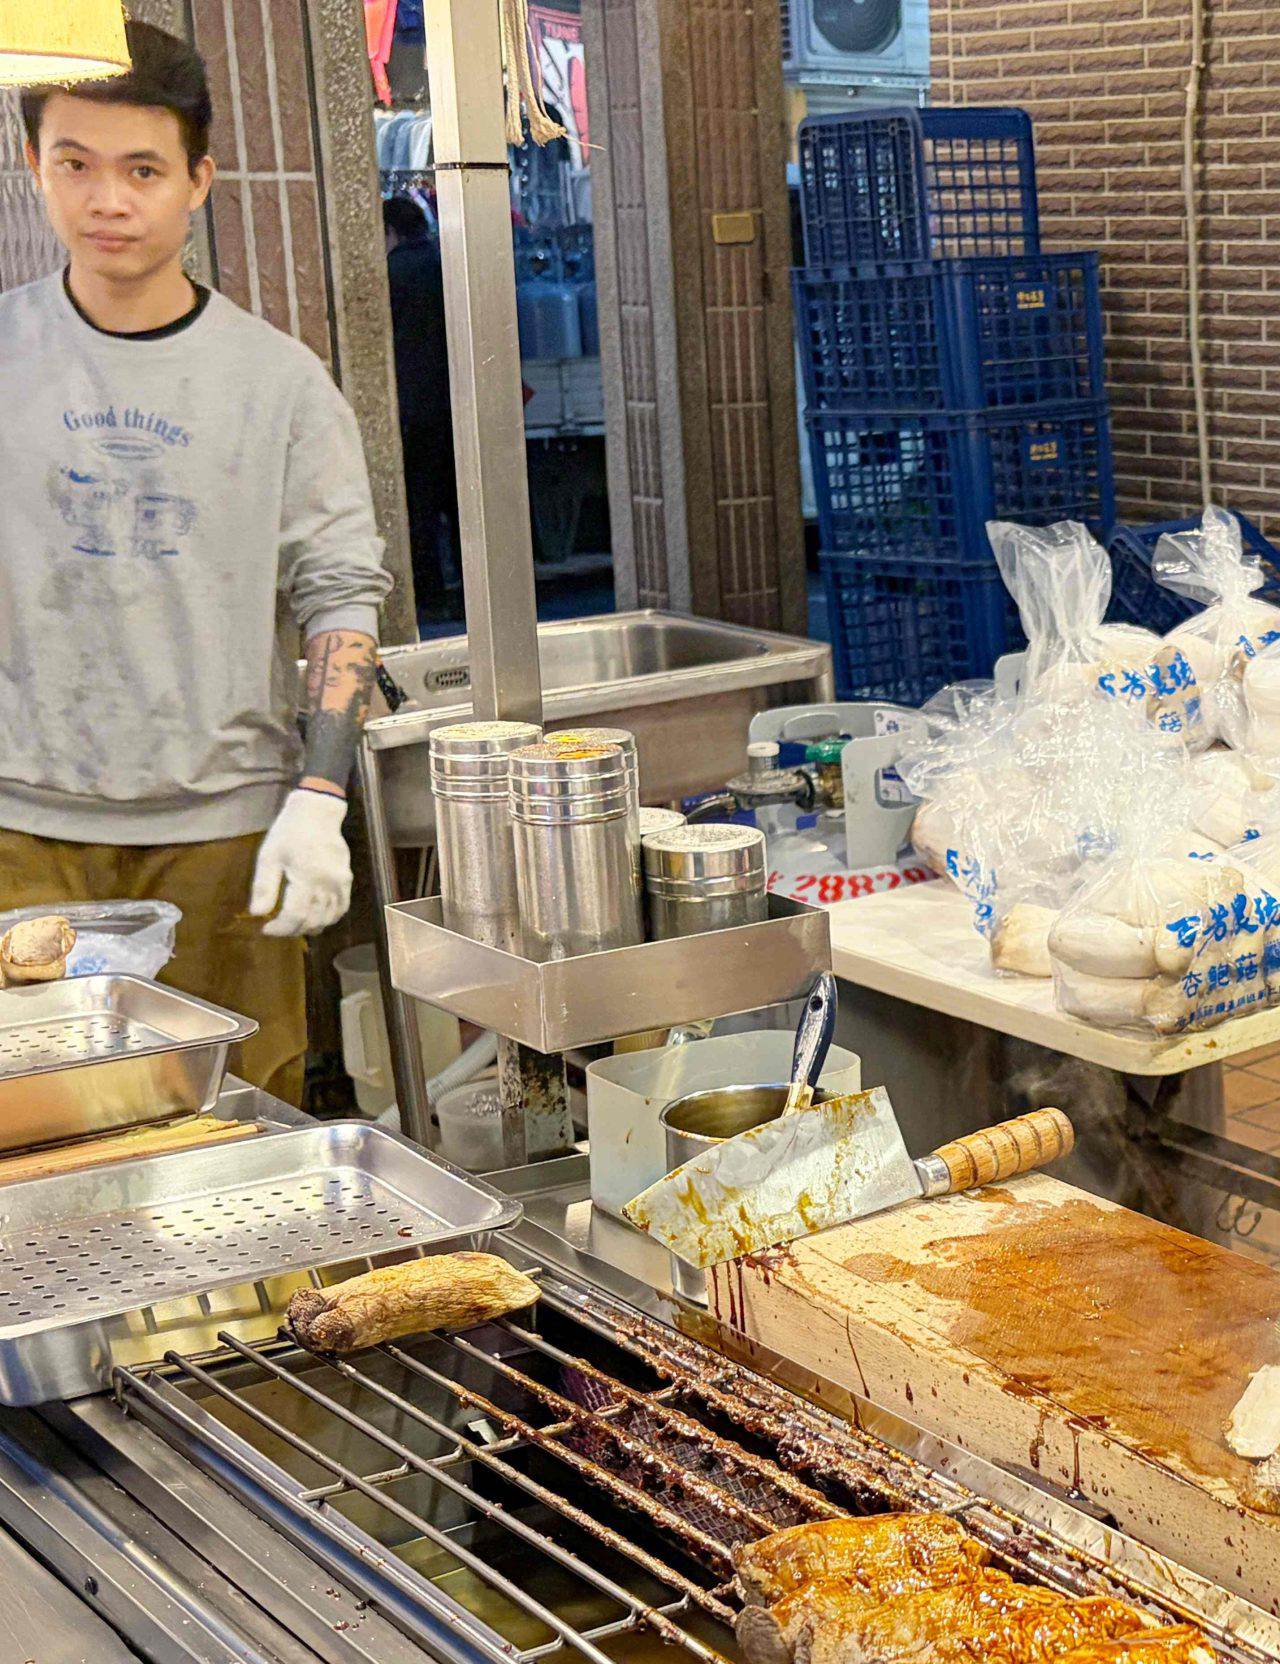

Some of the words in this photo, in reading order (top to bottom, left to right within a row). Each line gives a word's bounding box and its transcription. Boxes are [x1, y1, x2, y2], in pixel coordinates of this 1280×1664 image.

[63, 405, 118, 432] Good
[123, 407, 192, 448] things
[1181, 951, 1260, 999] 杏鮑菇
